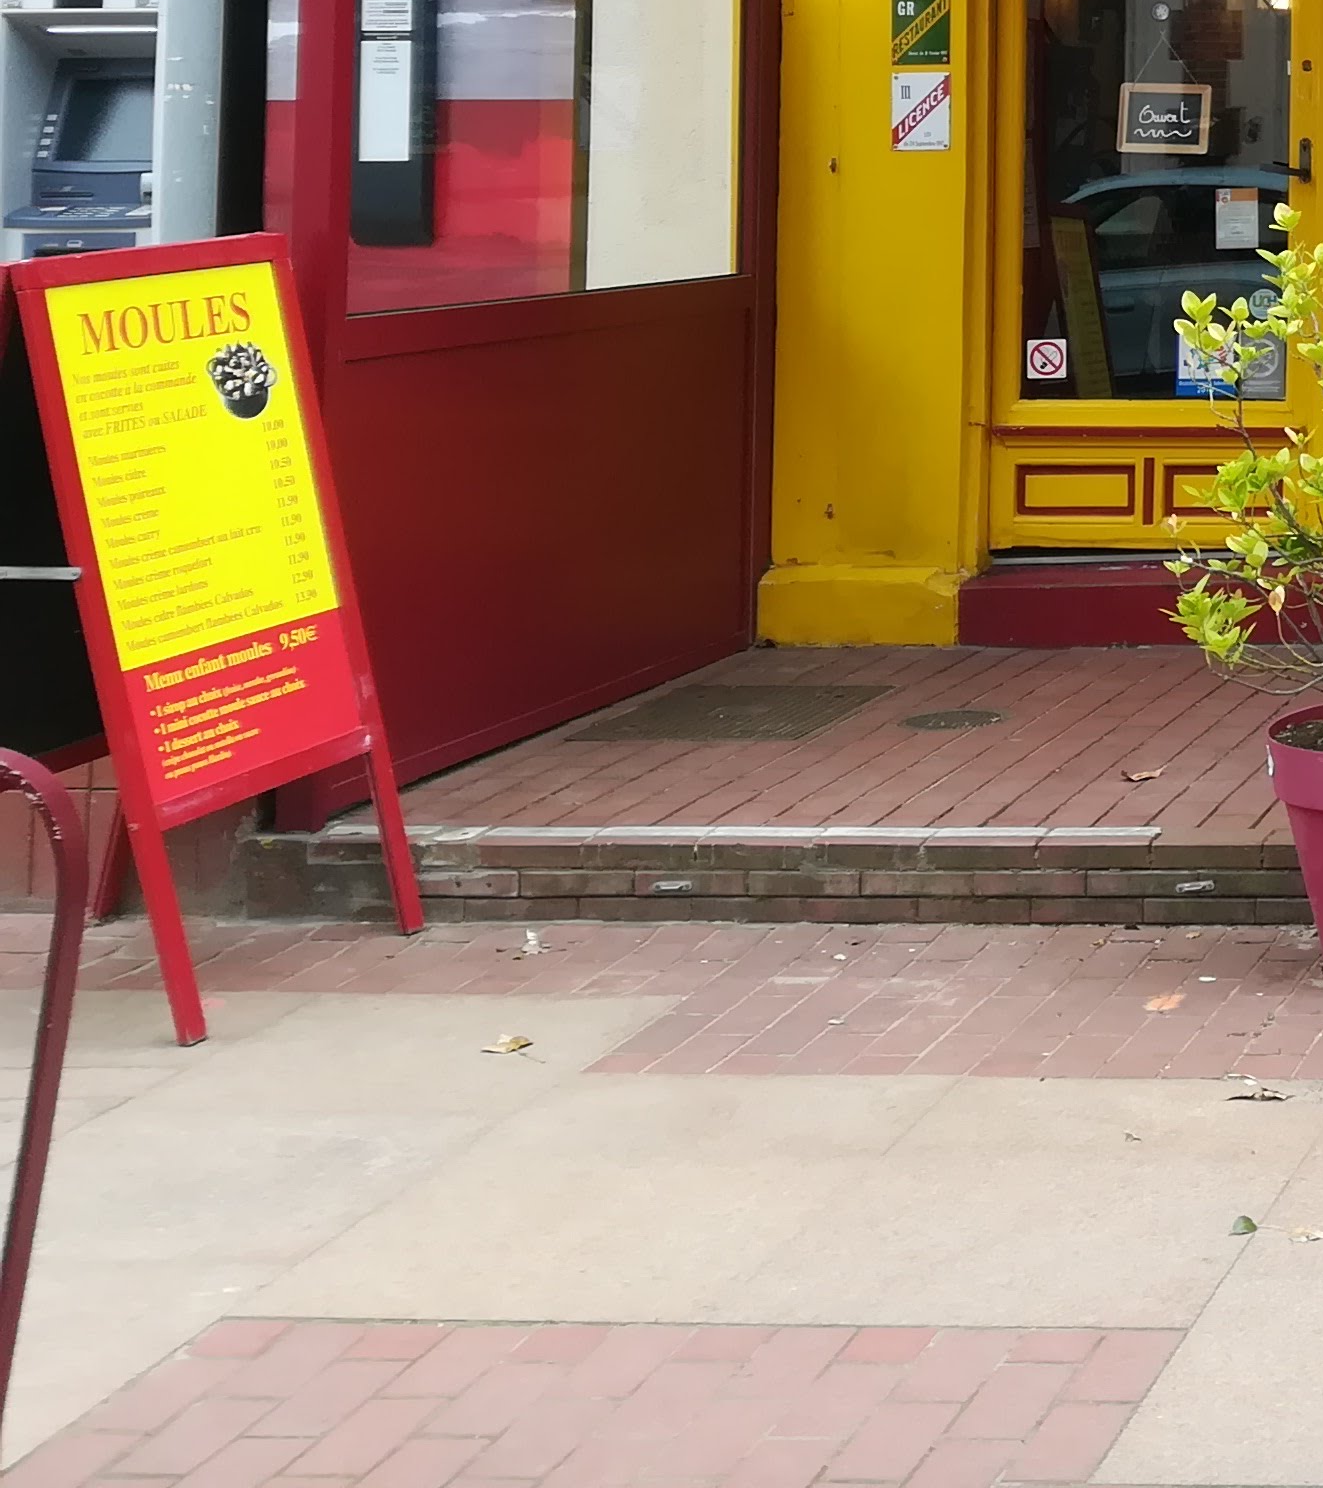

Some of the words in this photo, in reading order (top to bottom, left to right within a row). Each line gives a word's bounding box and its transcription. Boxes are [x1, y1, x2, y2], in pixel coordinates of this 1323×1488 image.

[897, 1, 915, 16] GR
[898, 83, 945, 140] LICENCE
[77, 291, 252, 357] MOULES
[105, 415, 146, 436] FRITES
[163, 404, 208, 424] SALADE
[136, 529, 161, 544] curry
[144, 671, 183, 693] Menu
[184, 653, 226, 680] enfant
[226, 641, 274, 666] moules
